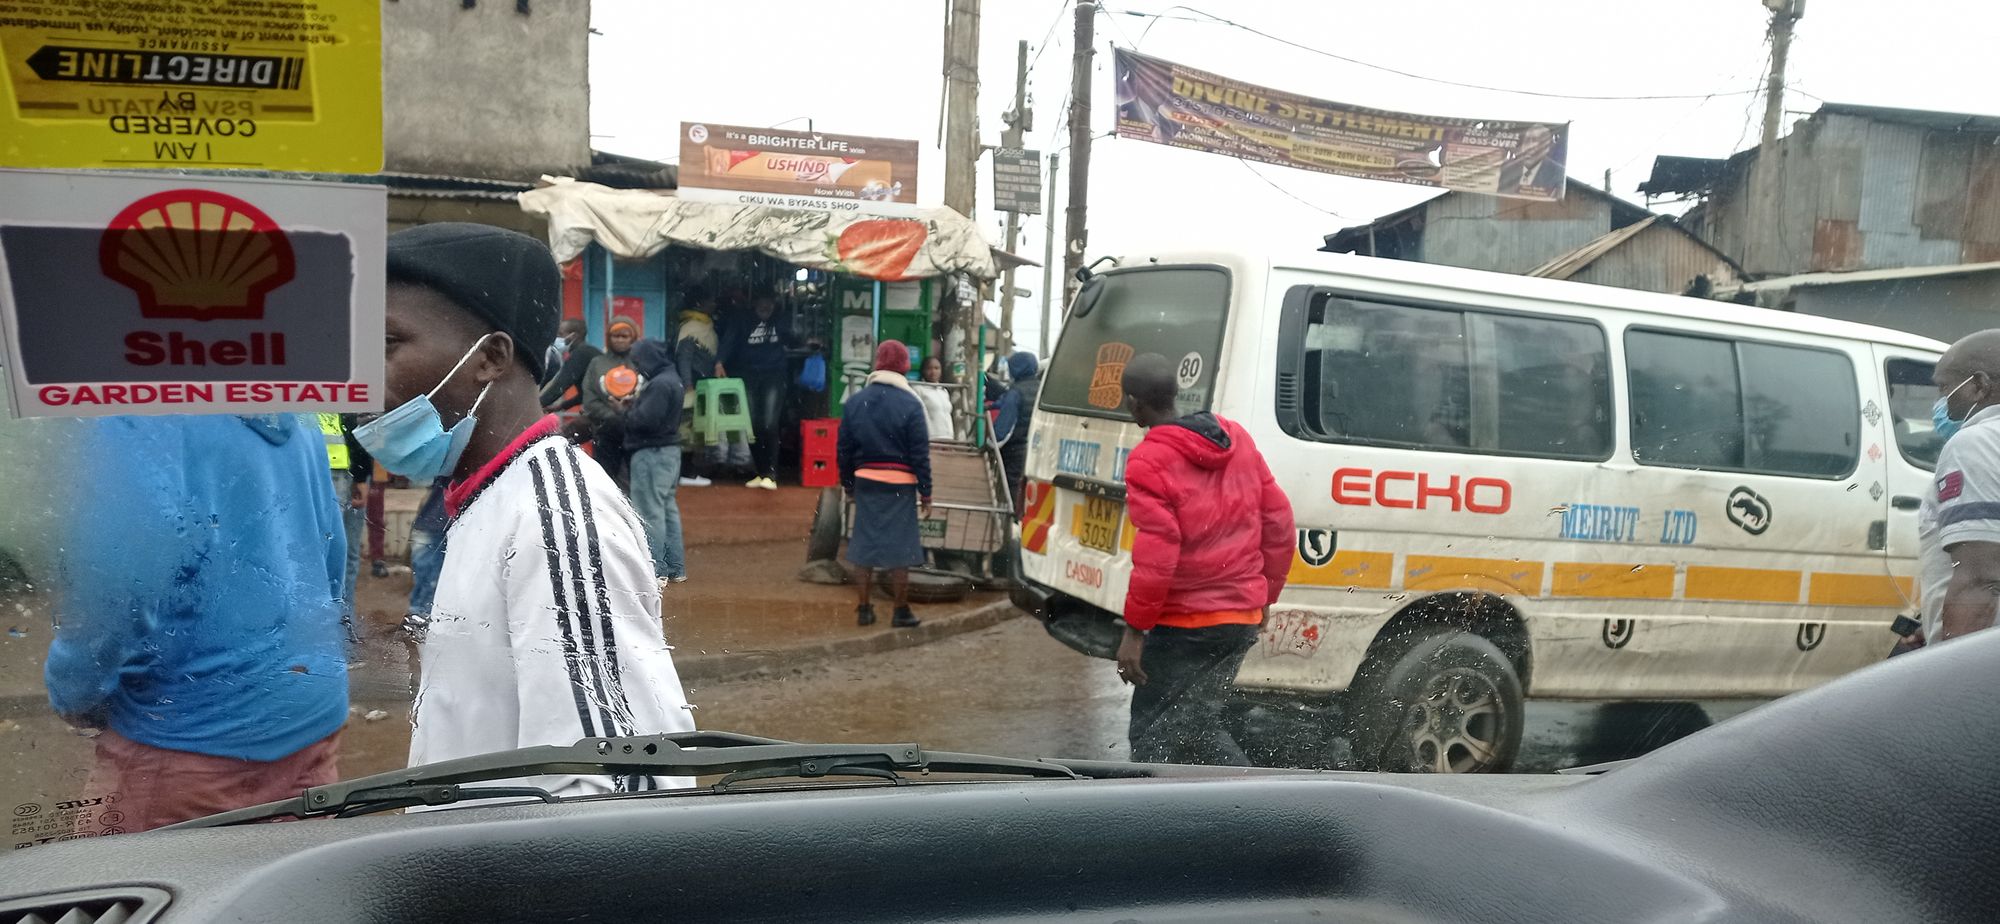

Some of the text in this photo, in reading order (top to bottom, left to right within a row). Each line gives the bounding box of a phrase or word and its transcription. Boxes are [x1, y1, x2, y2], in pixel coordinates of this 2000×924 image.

[0, 18, 80, 32] immediate
[85, 23, 103, 32] us
[107, 22, 148, 35] notify
[221, 30, 238, 40] an
[240, 31, 255, 42] of
[259, 32, 295, 43] event
[300, 33, 320, 44] the
[138, 38, 230, 51] ASSURANCE
[58, 51, 273, 85] DIRECTLINE
[158, 91, 198, 111] BY
[1172, 76, 1270, 113] DIVINE
[1277, 102, 1444, 142] SETTLEMENT
[110, 115, 257, 138] COVERED
[748, 134, 816, 149] BRIGHTER
[820, 140, 848, 152] LIFE
[1175, 131, 1224, 148] ANOINTING
[153, 142, 213, 161] I AM
[814, 186, 836, 196] Now
[838, 187, 855, 197] With
[738, 194, 860, 211] CIKU WA BYPASS SHOP
[124, 330, 286, 367] Shell
[1179, 357, 1200, 378] 80
[38, 383, 369, 407] GARDEN ESTATE
[1559, 502, 1698, 545] MEIRUT LTD
[1066, 559, 1103, 589] CASINO
